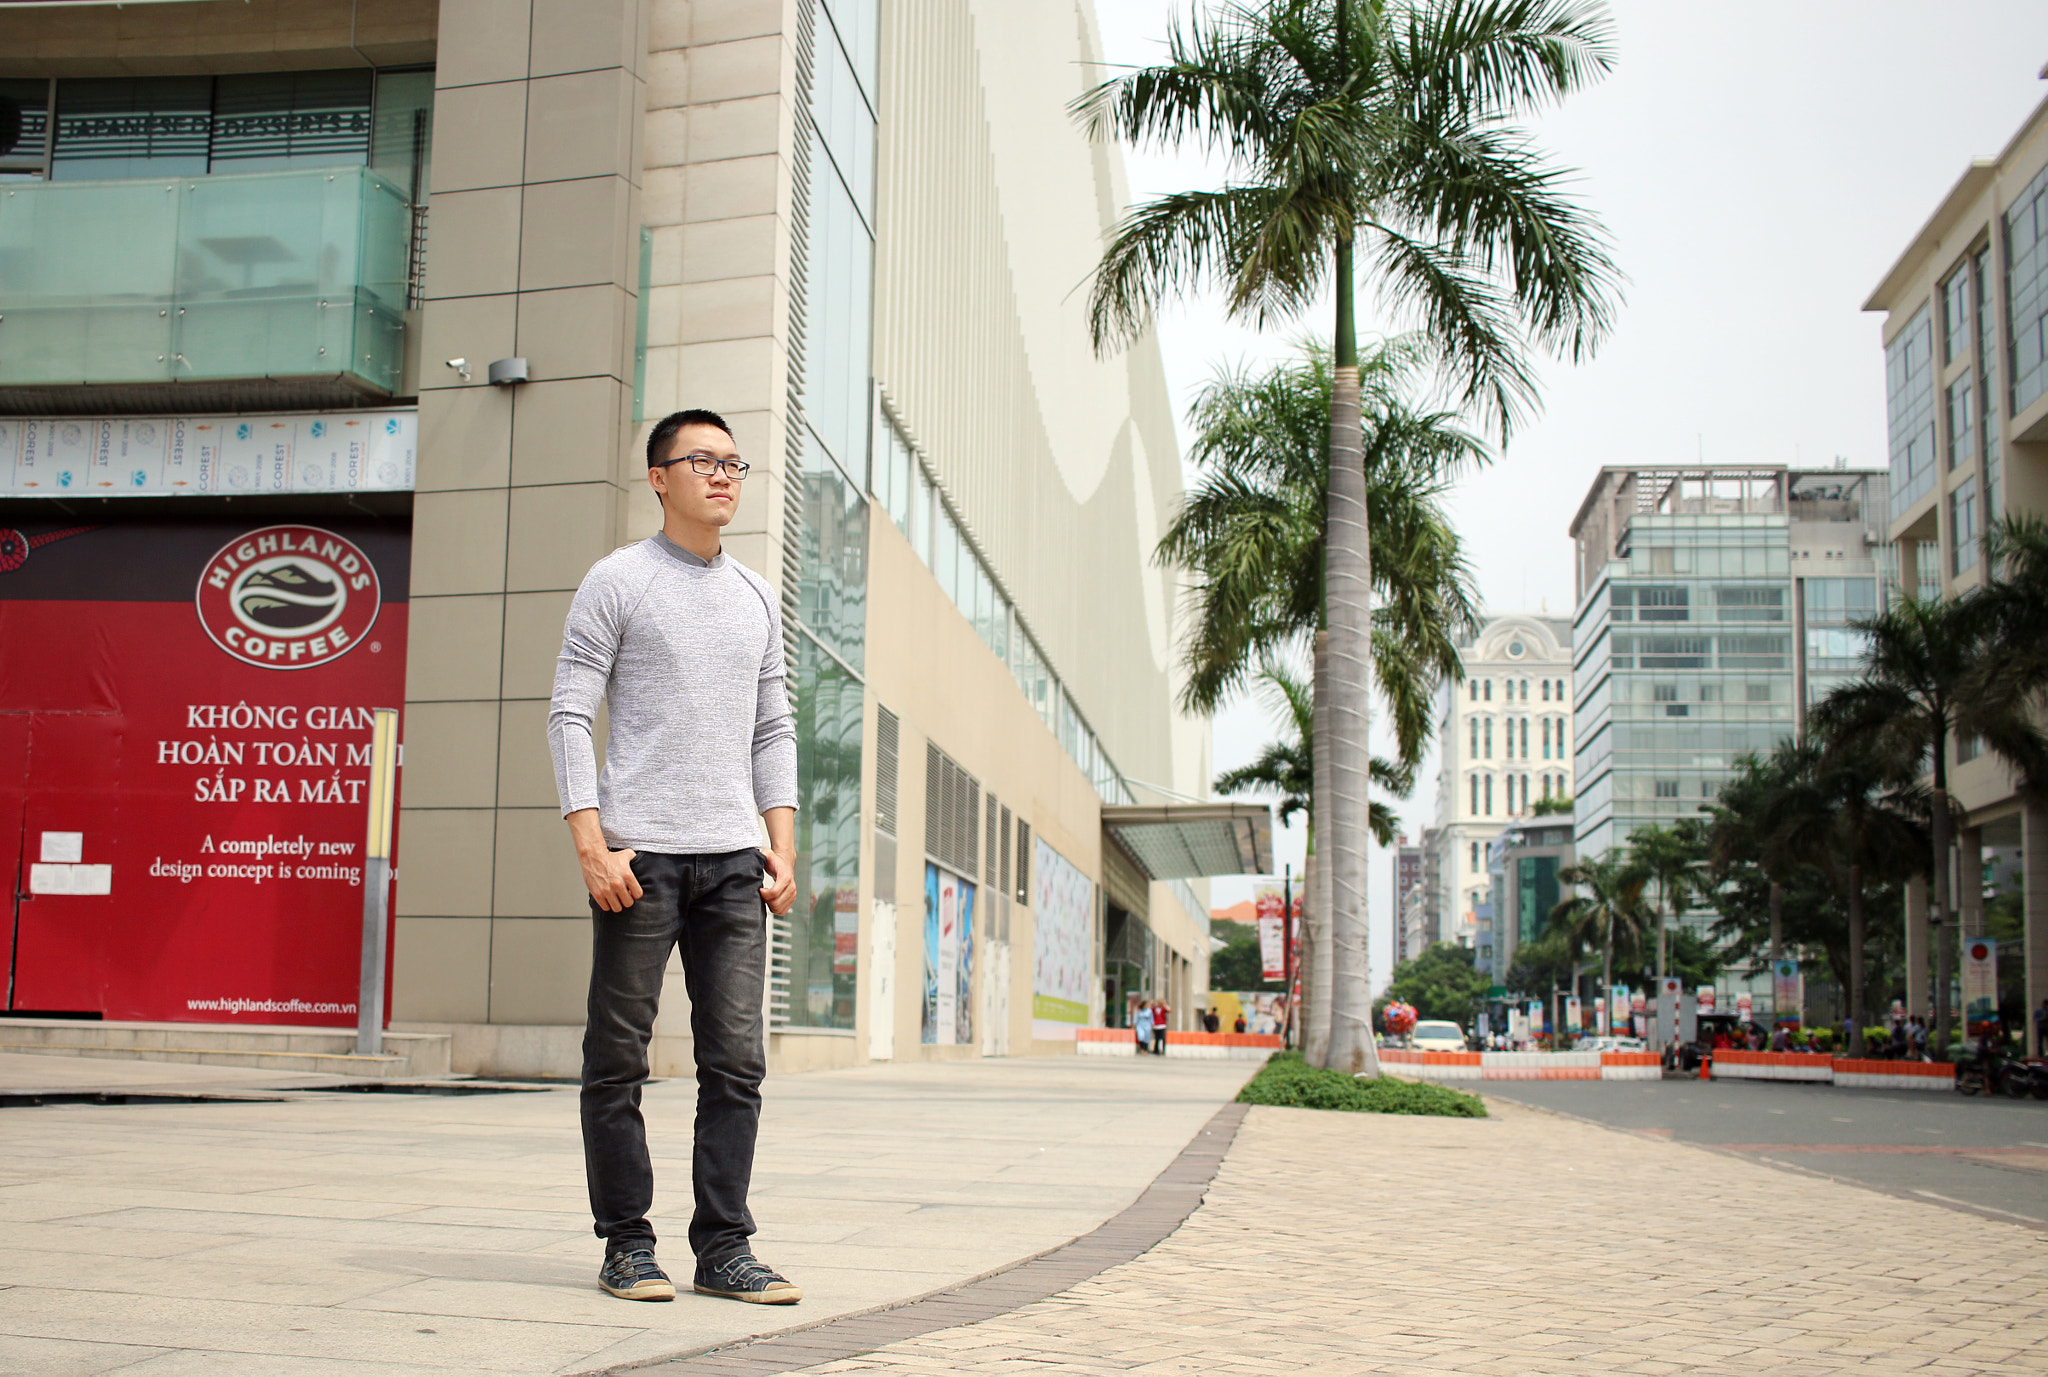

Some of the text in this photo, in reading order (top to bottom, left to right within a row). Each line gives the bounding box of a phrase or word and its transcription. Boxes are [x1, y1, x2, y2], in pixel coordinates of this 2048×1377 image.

[208, 533, 371, 591] HIGHLANDS
[225, 626, 350, 661] COFFEE
[187, 700, 376, 730] KHÔNG GIAN
[157, 735, 245, 765] HOÀN
[253, 736, 338, 766] TOÀN
[195, 767, 366, 804] SẮP RA MẮT
[201, 834, 356, 860] A completely new
[150, 856, 361, 886] design concept is coming
[187, 997, 357, 1014] www.highlandscoffee.com.vn
